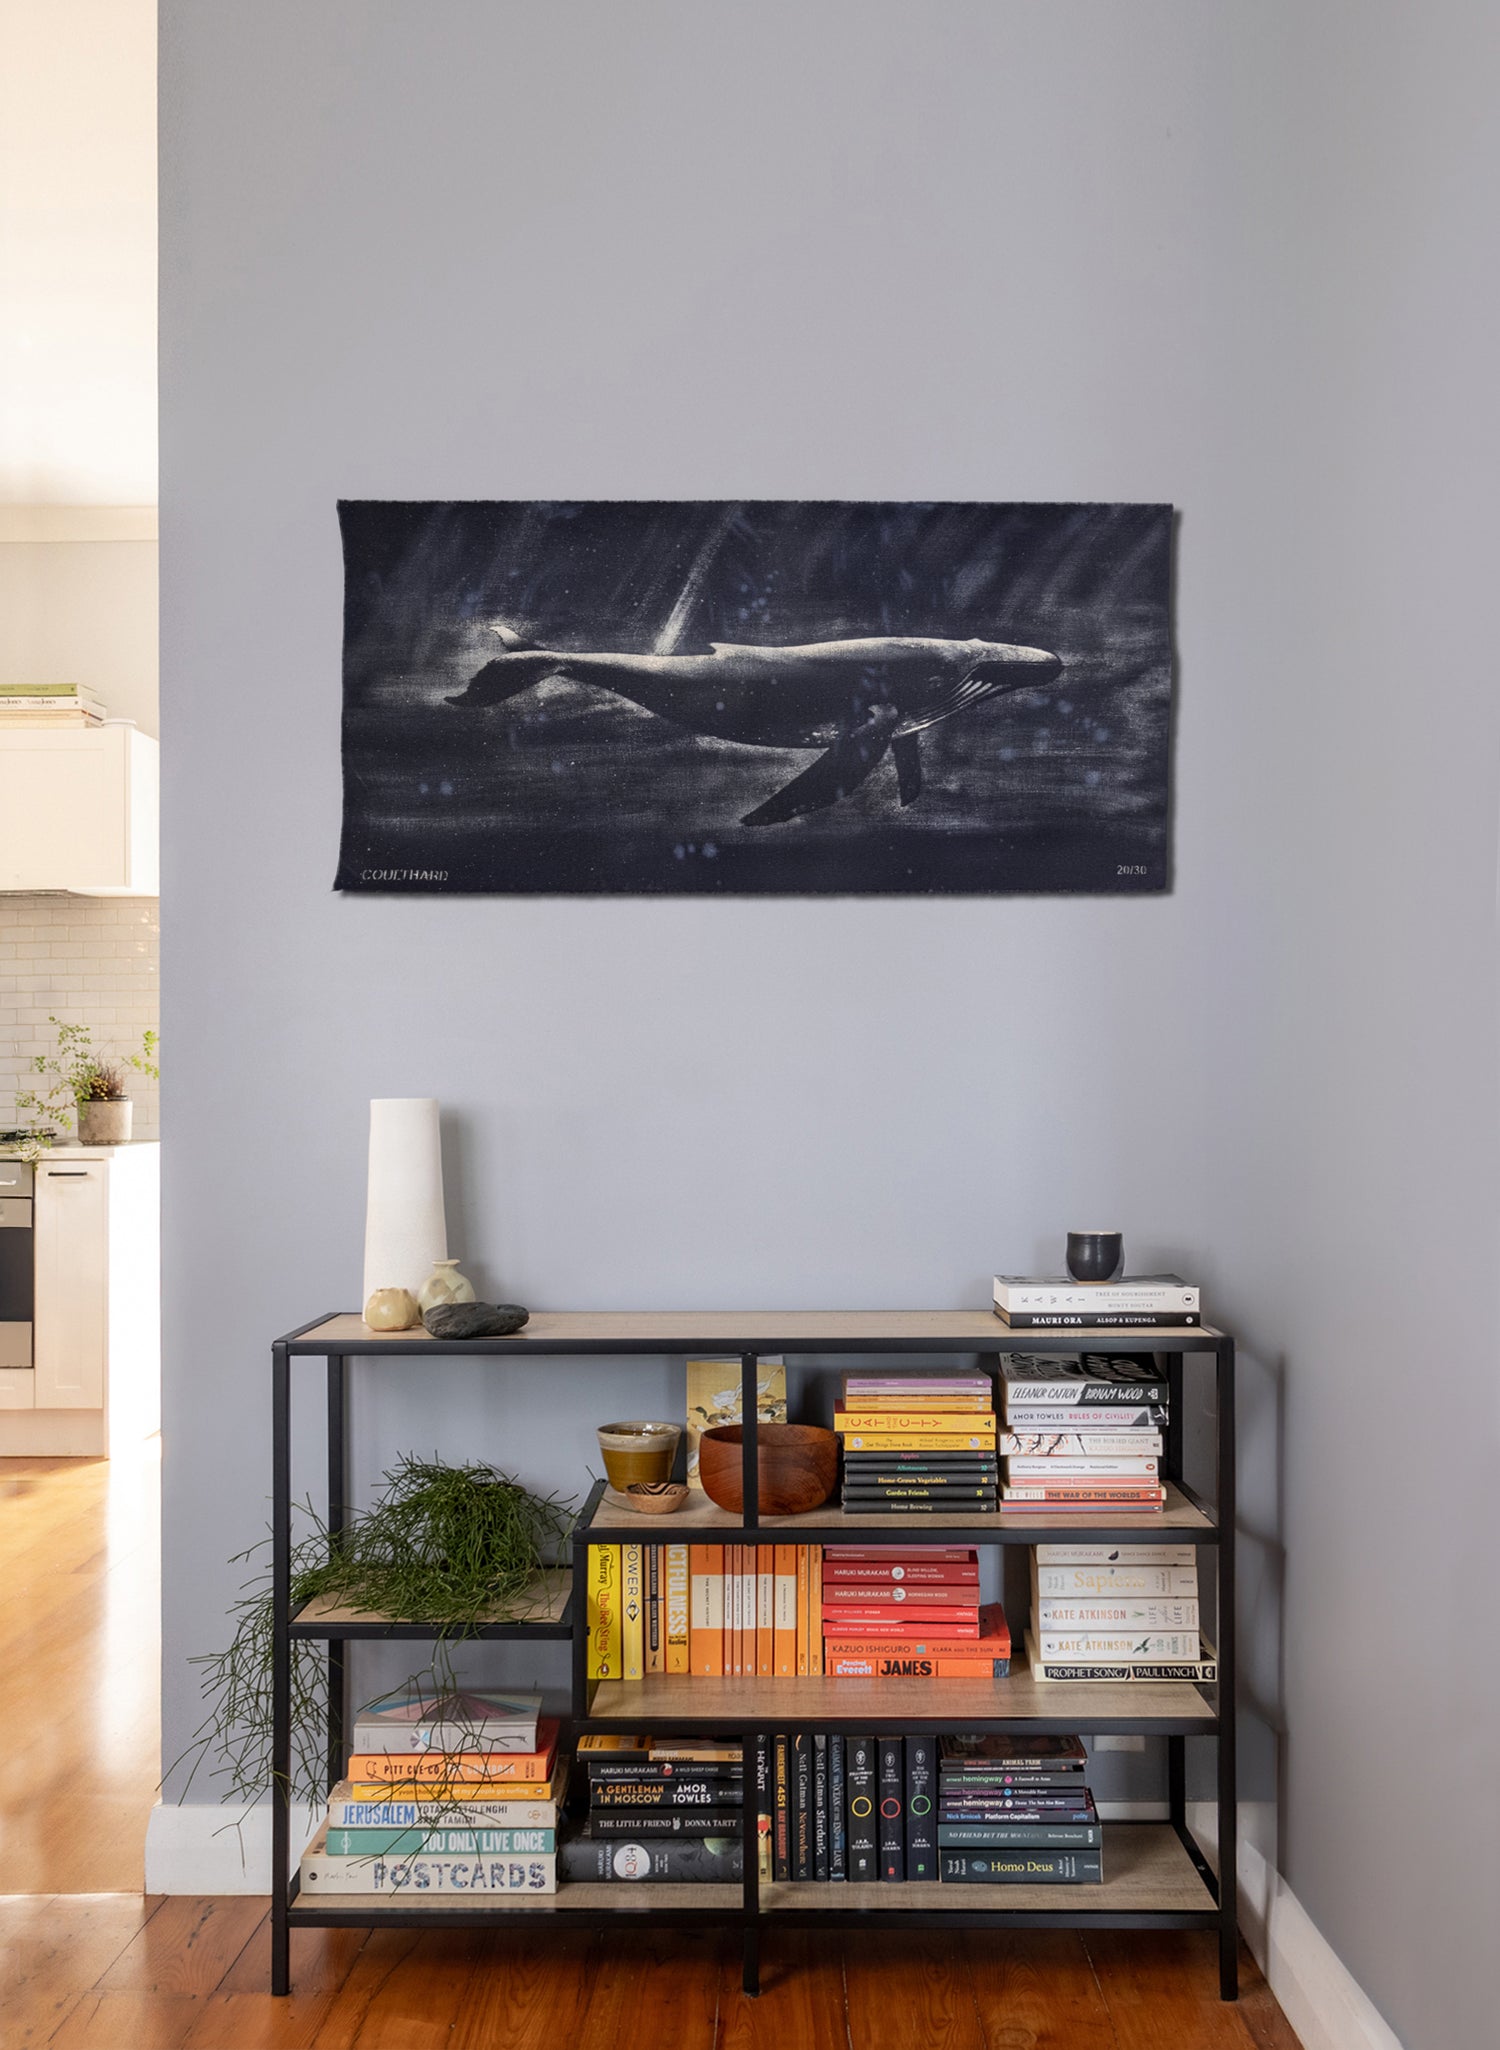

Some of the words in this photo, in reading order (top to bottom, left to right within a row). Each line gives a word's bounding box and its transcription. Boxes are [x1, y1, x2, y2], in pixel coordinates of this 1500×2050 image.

[1116, 864, 1148, 875] 20/30
[1031, 1317, 1062, 1325] MAURI
[1063, 1317, 1083, 1325] ORA
[1012, 1387, 1048, 1400] ELEANOR
[1047, 1387, 1079, 1400] CATTON
[1084, 1388, 1117, 1400] BIRNAM
[1117, 1388, 1144, 1400] WOOD
[850, 1418, 885, 1427] CAT
[899, 1418, 943, 1427] CITY
[598, 1554, 610, 1585] Murray
[1073, 1571, 1146, 1593] Sapiens
[599, 1592, 610, 1609] The
[599, 1610, 610, 1626] Bee
[1051, 1609, 1075, 1620] KATE
[1078, 1609, 1127, 1620] ATKINSON
[1148, 1606, 1157, 1625] LIFE
[1174, 1605, 1183, 1625] LIFE
[598, 1628, 610, 1652] Sting
[1058, 1640, 1081, 1650] KATE
[1084, 1640, 1134, 1650] ATKINSON
[832, 1645, 864, 1653] KAZUO
[865, 1645, 911, 1653] ISHIGURO
[836, 1665, 873, 1674] Everett
[880, 1660, 932, 1676] JAMES
[1047, 1668, 1093, 1679] PROPHET
[1094, 1668, 1123, 1679] SONG
[1135, 1667, 1160, 1677] PAUL
[1161, 1667, 1196, 1677] LYNCH
[777, 1744, 786, 1785] FAHRENHEIT
[799, 1753, 808, 1772] Neil
[816, 1752, 825, 1770] Neil
[384, 1764, 403, 1774] PITT
[427, 1764, 440, 1774] CO
[757, 1751, 765, 1791] HOBBIT
[962, 1775, 1003, 1784] hemingway
[597, 1786, 603, 1794] A
[606, 1785, 664, 1794] GENTLEMAN
[676, 1784, 707, 1793] AMOR
[799, 1774, 808, 1809] Gaiman
[816, 1772, 825, 1807] Gaiman
[962, 1788, 1002, 1797] hemingway
[601, 1794, 610, 1803] IN
[614, 1794, 662, 1804] MOSCOW
[672, 1794, 712, 1803] TOWLES
[778, 1786, 786, 1807] 451
[963, 1799, 1003, 1808] hemingway
[342, 1804, 415, 1825] JERUSALEM
[778, 1810, 786, 1822] RAY
[1010, 1813, 1040, 1821] Capitalism
[598, 1820, 615, 1828] THE
[616, 1820, 642, 1828] LITTLE
[643, 1820, 672, 1828] FRIEND
[685, 1819, 711, 1828] DONNA
[713, 1819, 737, 1827] TARTT
[421, 1832, 446, 1851] YOU
[448, 1832, 478, 1851] ONLY
[482, 1832, 510, 1851] LIVE
[513, 1832, 545, 1851] ONCE
[778, 1823, 787, 1859] BRADBURY
[799, 1812, 809, 1865] Neverwhere
[991, 1861, 1025, 1872] Homo
[1027, 1861, 1054, 1872] Deus
[373, 1862, 546, 1888] POSTCARDS
